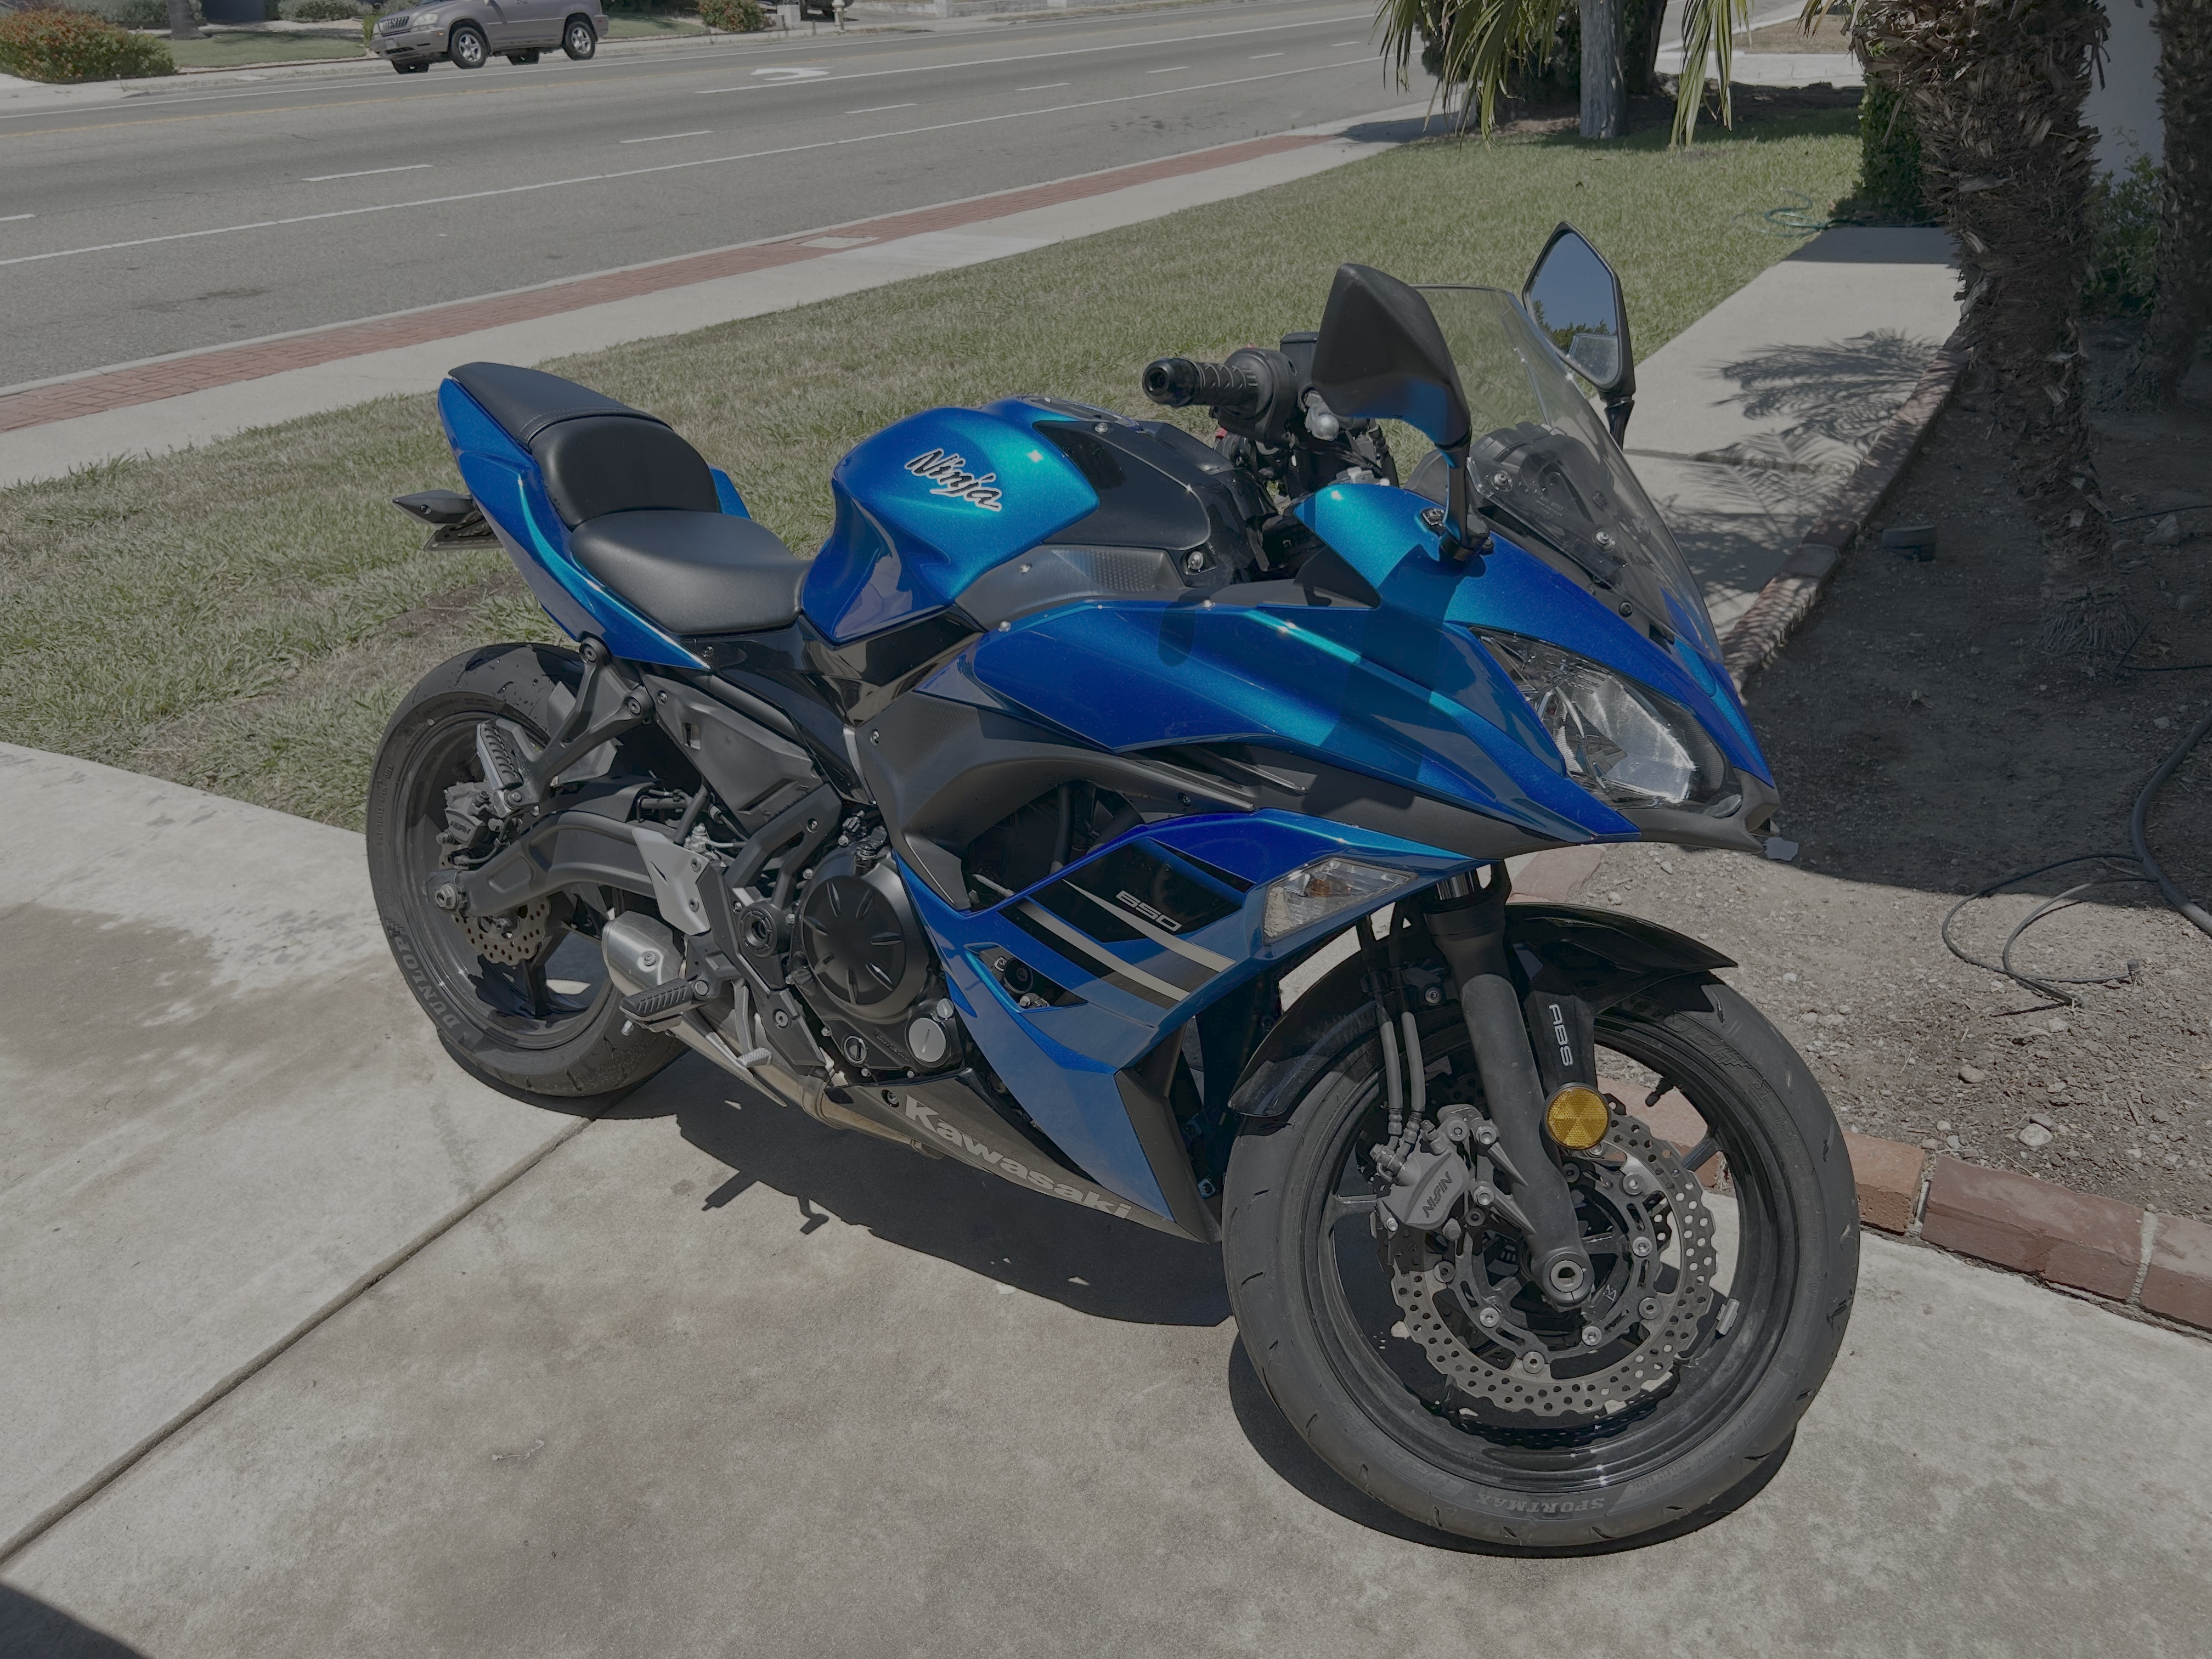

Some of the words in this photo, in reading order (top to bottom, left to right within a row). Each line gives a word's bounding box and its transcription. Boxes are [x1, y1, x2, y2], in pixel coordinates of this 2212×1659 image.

[905, 448, 1001, 511] Ninja
[1116, 890, 1182, 932] 650
[394, 936, 460, 1029] DUNLOP
[1548, 1004, 1573, 1066] ABS
[906, 1094, 1132, 1219] Kawasaki
[1423, 1171, 1452, 1218] NISSIN
[1632, 1475, 1656, 1489] RADIAL
[1658, 1459, 1689, 1480] TUBELESS
[1474, 1492, 1605, 1513] SPORTMAX
